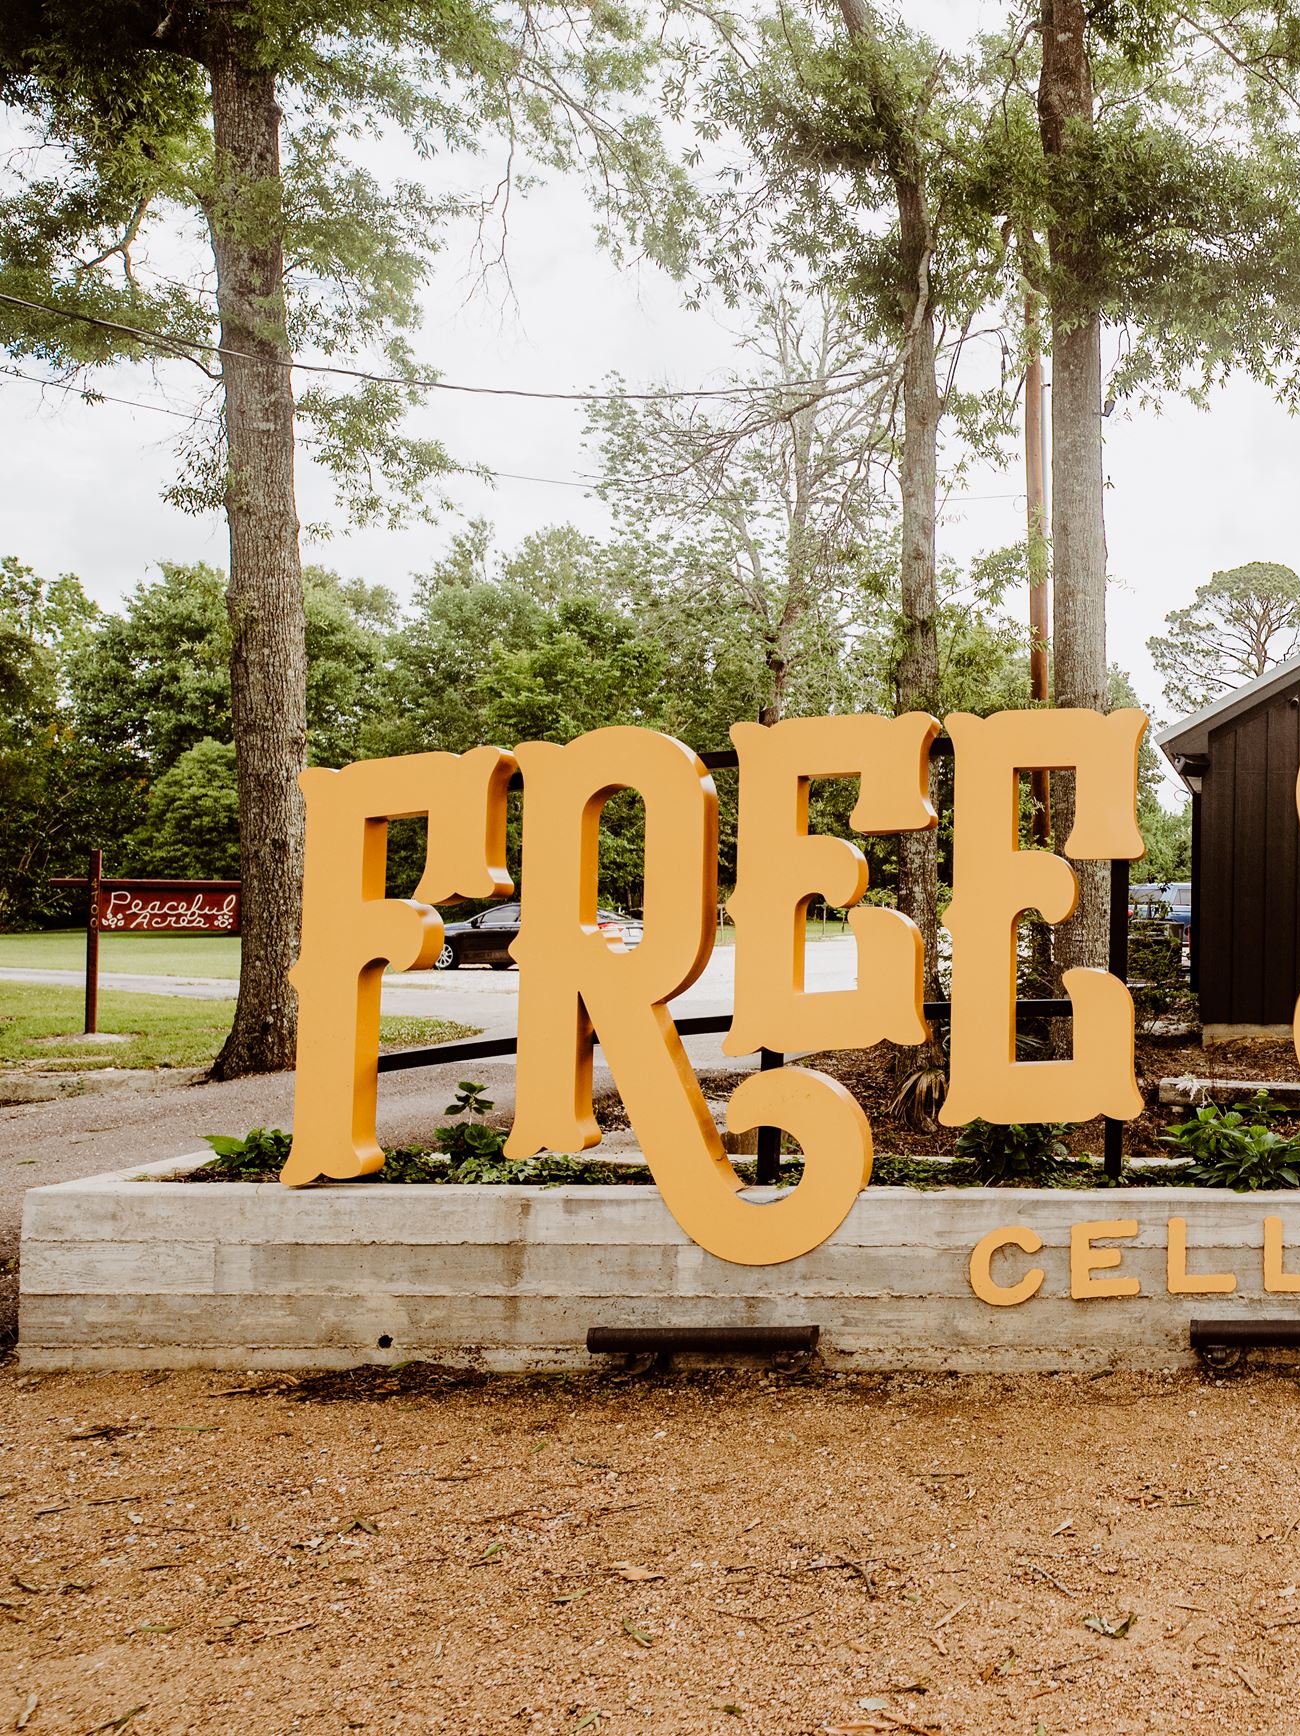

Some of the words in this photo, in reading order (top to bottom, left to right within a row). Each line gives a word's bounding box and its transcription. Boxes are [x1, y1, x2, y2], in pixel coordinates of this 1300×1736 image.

[107, 891, 237, 920] Peaceful
[129, 912, 210, 929] Acres
[279, 706, 1150, 1266] FREE
